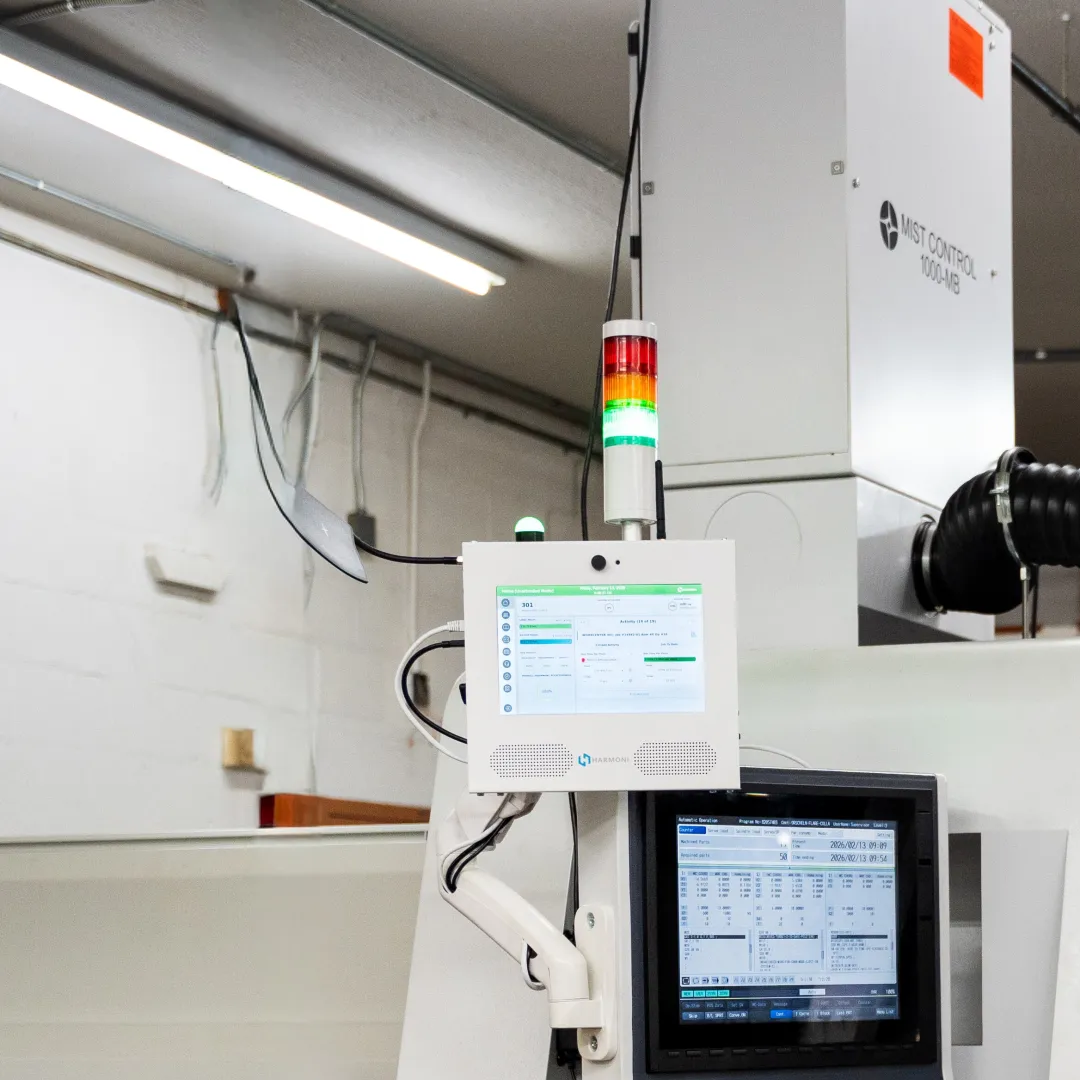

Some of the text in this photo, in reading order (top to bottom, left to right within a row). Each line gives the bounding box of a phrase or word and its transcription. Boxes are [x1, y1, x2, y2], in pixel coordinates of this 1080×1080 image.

[901, 213, 977, 280] MIST CONTROL
[921, 254, 960, 295] 1000-MB
[830, 840, 866, 849] 2026/02/13
[780, 852, 787, 860] 50
[830, 854, 866, 862] 2026/02/13
